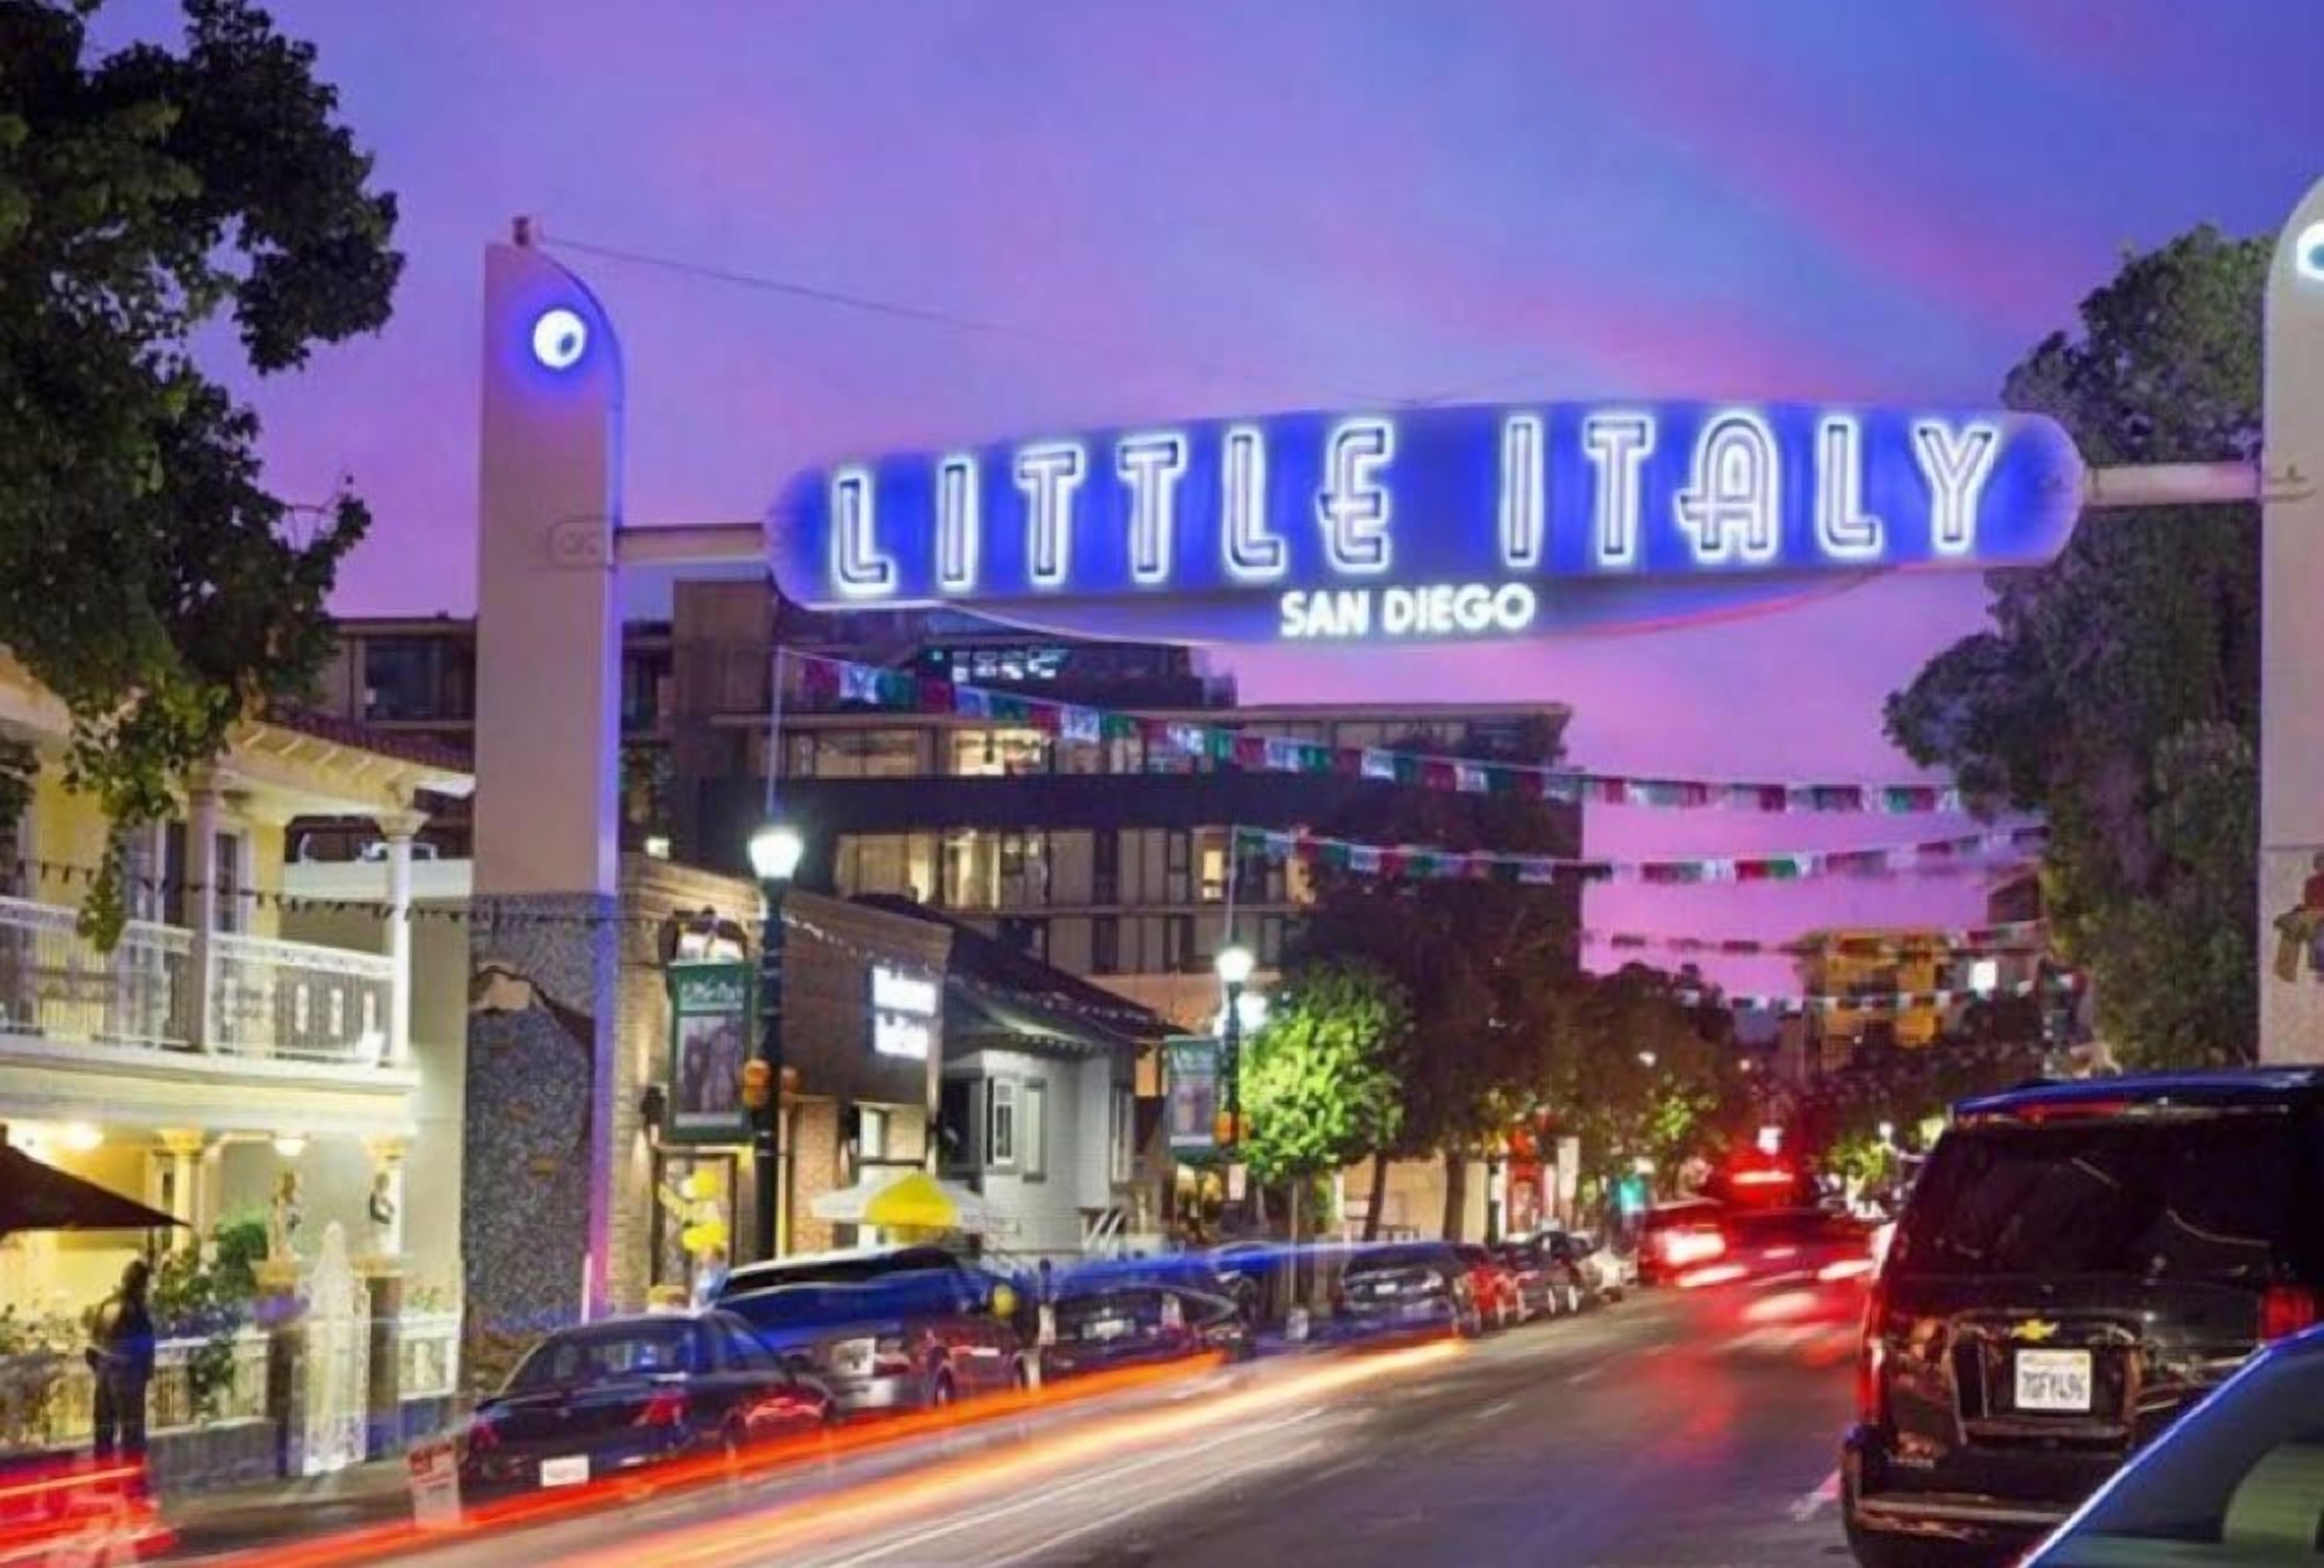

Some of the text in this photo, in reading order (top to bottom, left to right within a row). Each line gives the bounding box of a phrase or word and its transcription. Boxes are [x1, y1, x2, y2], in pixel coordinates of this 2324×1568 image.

[833, 410, 2000, 592] LITTLE ITALY
[1280, 583, 1536, 637] SAN DIEGO
